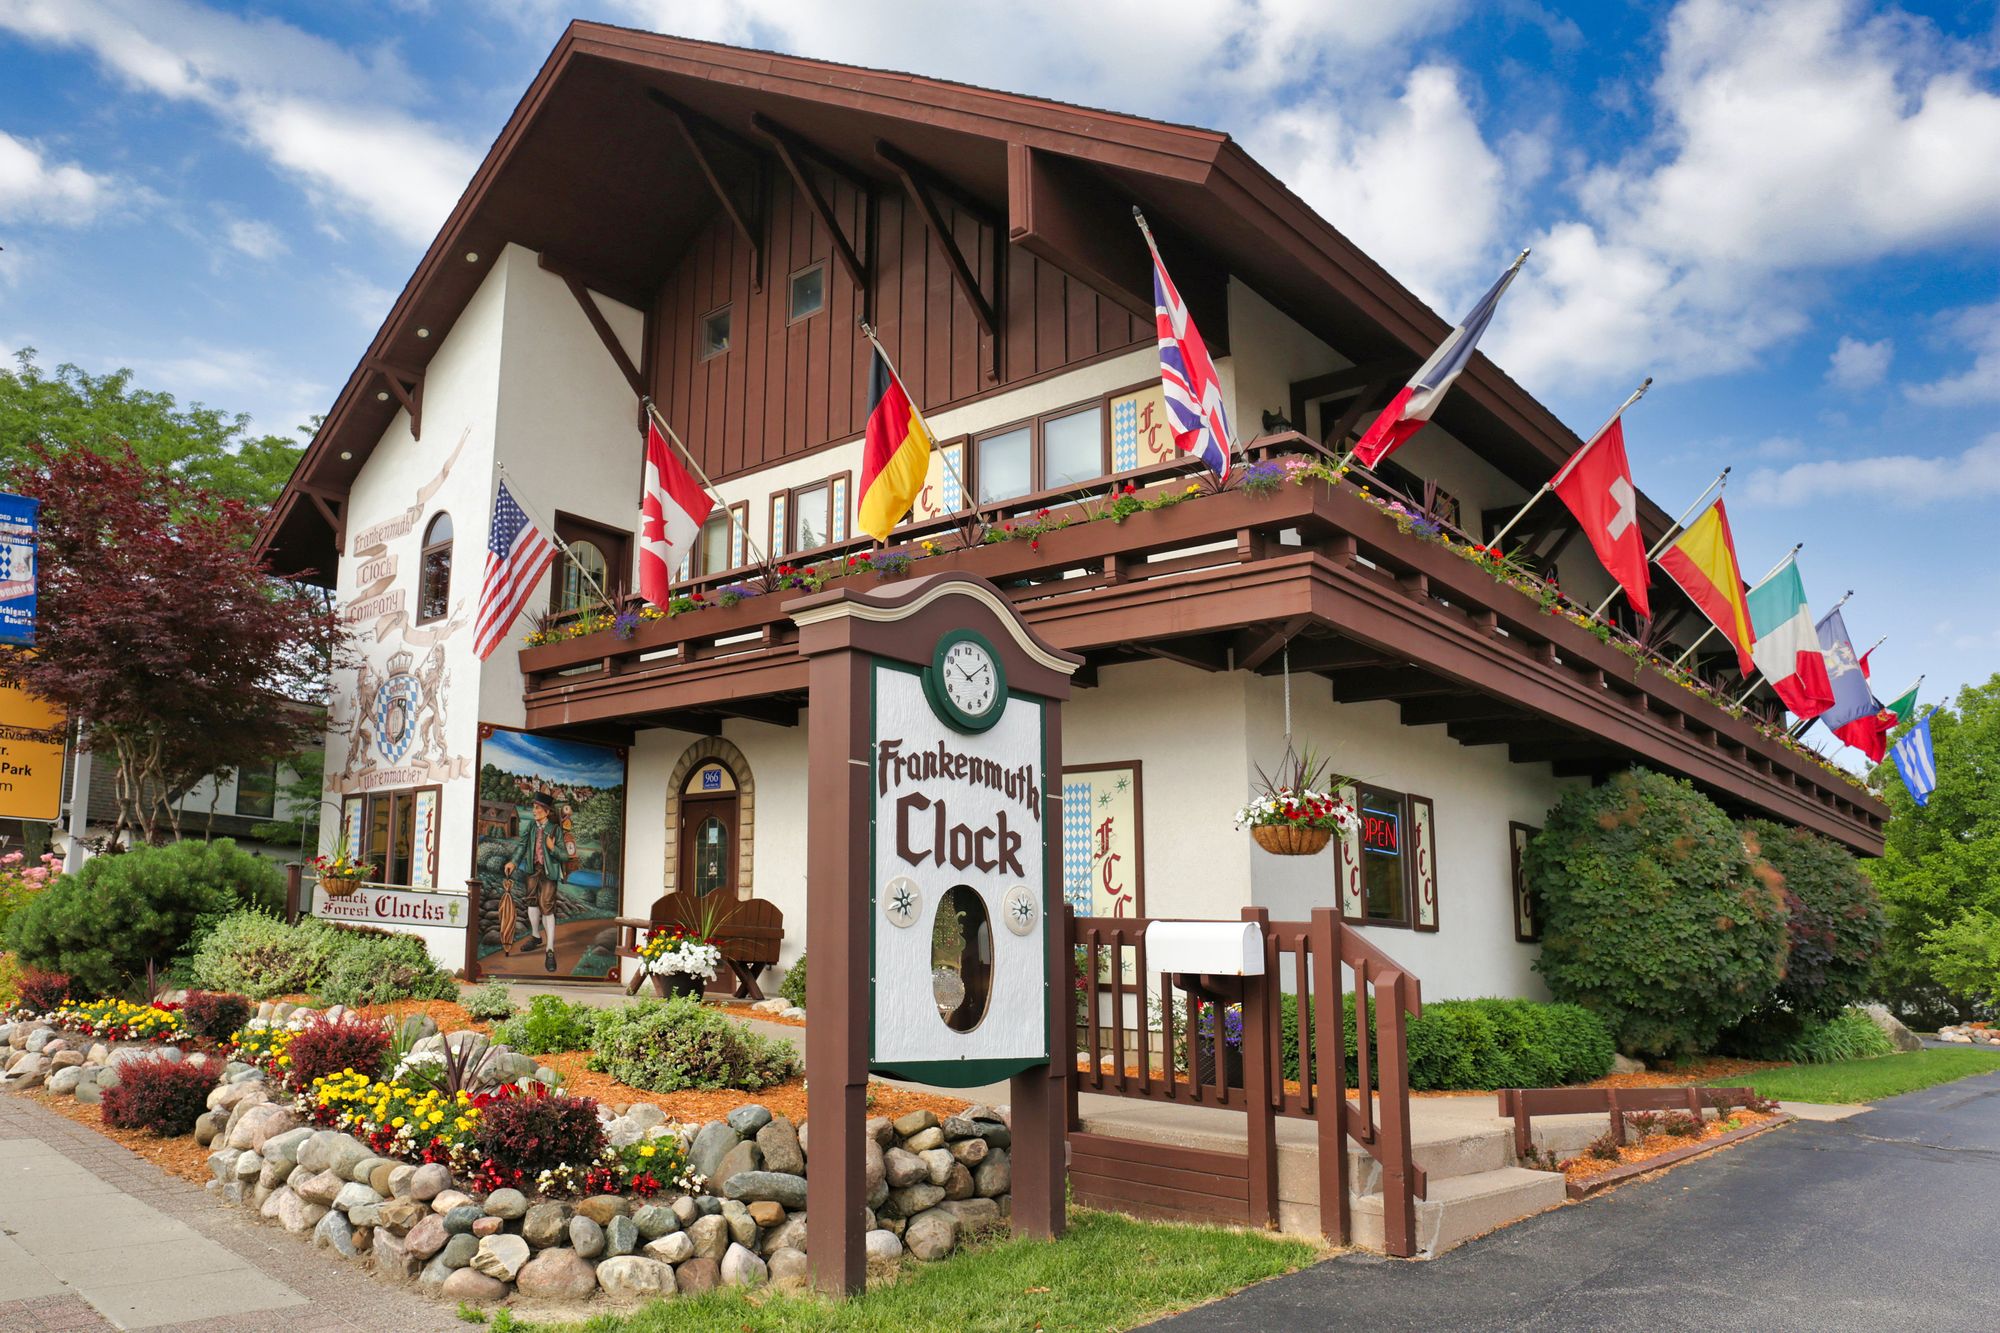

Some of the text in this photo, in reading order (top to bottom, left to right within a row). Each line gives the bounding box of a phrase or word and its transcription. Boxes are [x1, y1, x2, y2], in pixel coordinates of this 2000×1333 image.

[355, 519, 410, 551] Frankenmuth
[362, 559, 391, 584] Clock
[954, 648, 960, 656] 11
[965, 647, 972, 655] 12
[947, 656, 955, 665] 10
[946, 669, 951, 677] 9
[985, 677, 990, 685] 3
[948, 684, 953, 693] 8
[956, 695, 960, 703] 7
[977, 699, 982, 708] 5
[967, 702, 972, 710] 6
[2, 762, 32, 776] Park
[705, 770, 719, 784] 966
[878, 738, 1040, 823] Frankenmuth
[896, 791, 1025, 878] Clock
[321, 894, 445, 921] Forest Clocks
